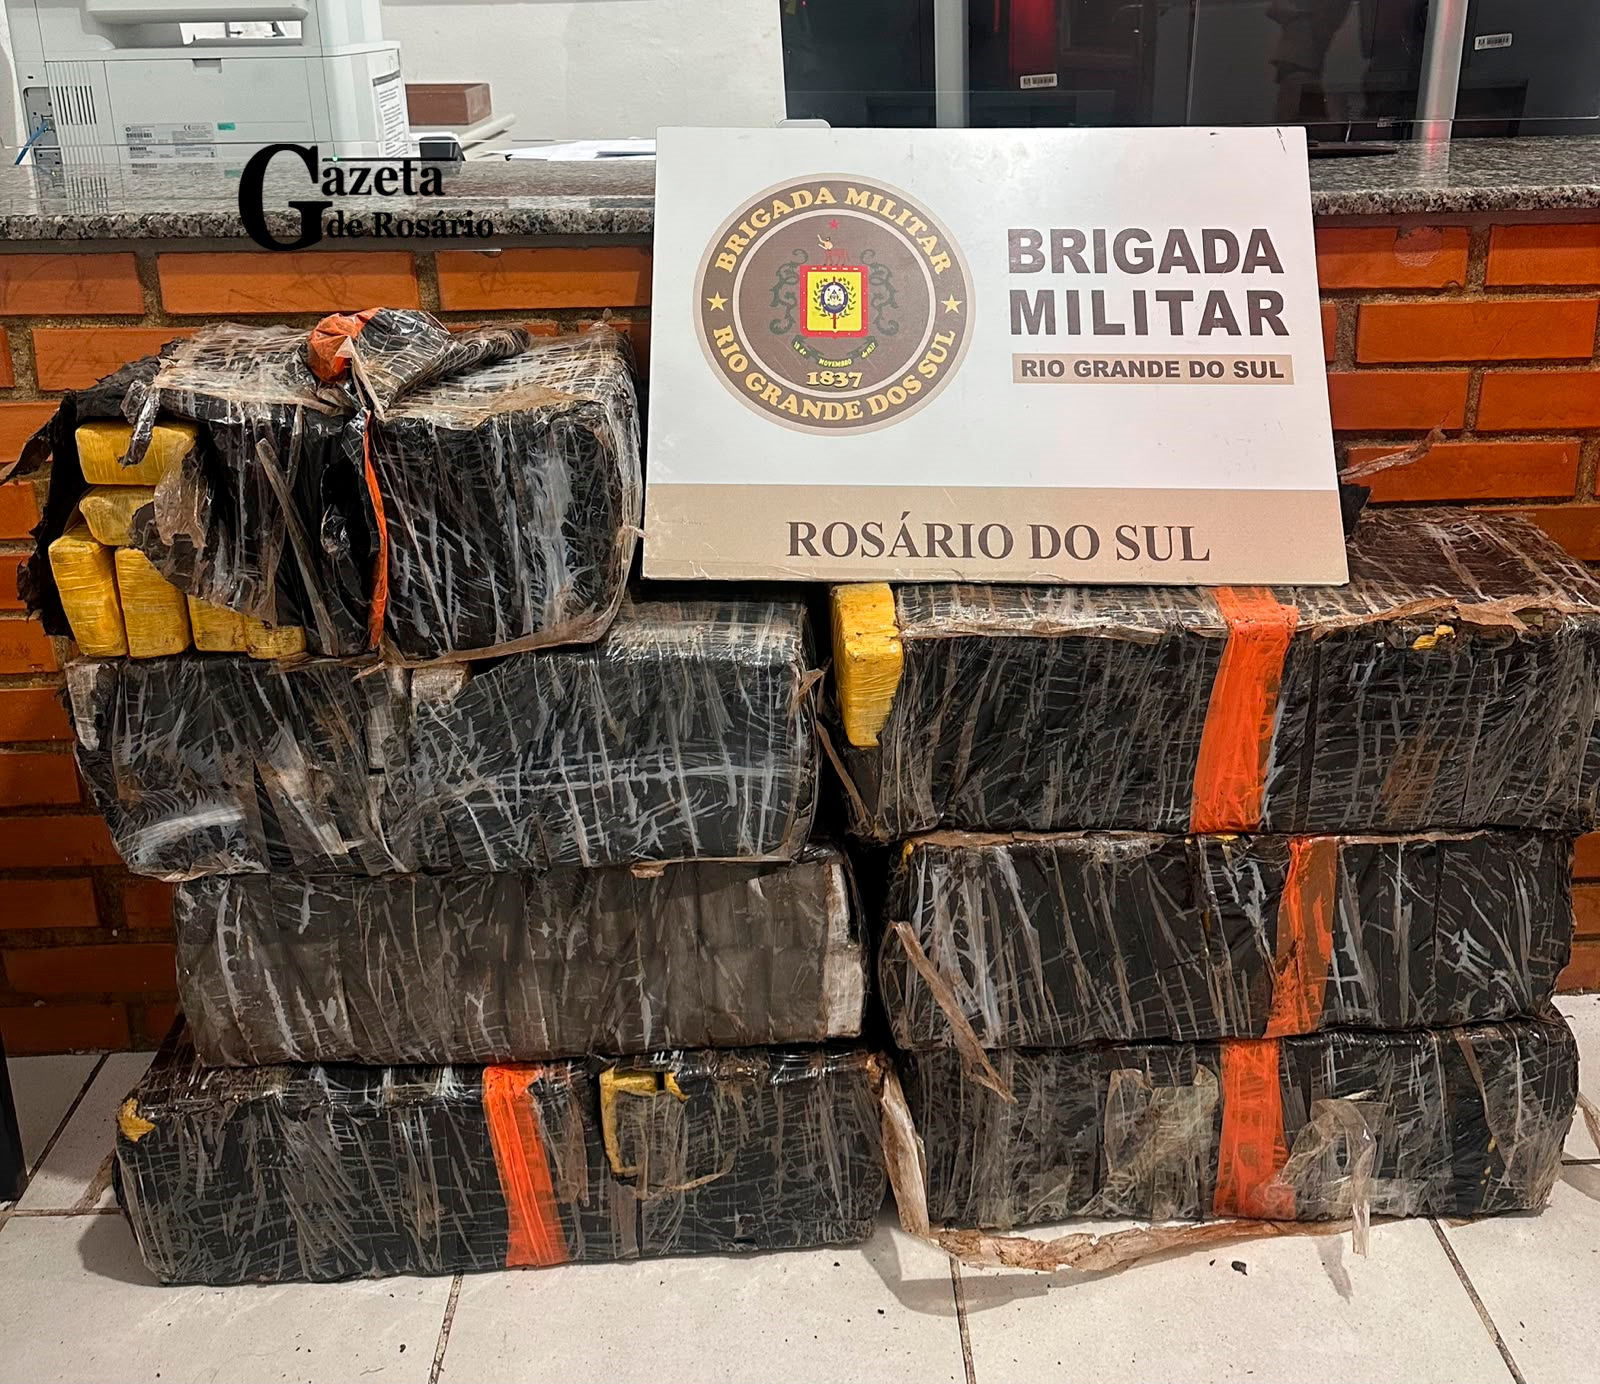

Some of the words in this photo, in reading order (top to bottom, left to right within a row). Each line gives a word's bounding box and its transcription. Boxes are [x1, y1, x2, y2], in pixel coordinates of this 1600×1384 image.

[715, 187, 837, 273] BRIGADA
[844, 188, 952, 275] MILITAR
[1007, 228, 1285, 274] BRIGADA
[1009, 290, 1290, 336] MILITAR
[713, 325, 749, 372] RIO
[745, 372, 864, 421] GRANDE
[865, 375, 923, 415] DOS
[917, 330, 956, 378] SUL
[806, 371, 863, 388] 1837
[1021, 360, 1065, 377] RIO
[1073, 360, 1180, 378] GRANDE
[1189, 361, 1225, 378] DO
[1233, 361, 1284, 379] SUL
[785, 511, 1014, 560] ROSÁRIO
[1027, 524, 1100, 560] DO
[1115, 525, 1210, 562] SUL
